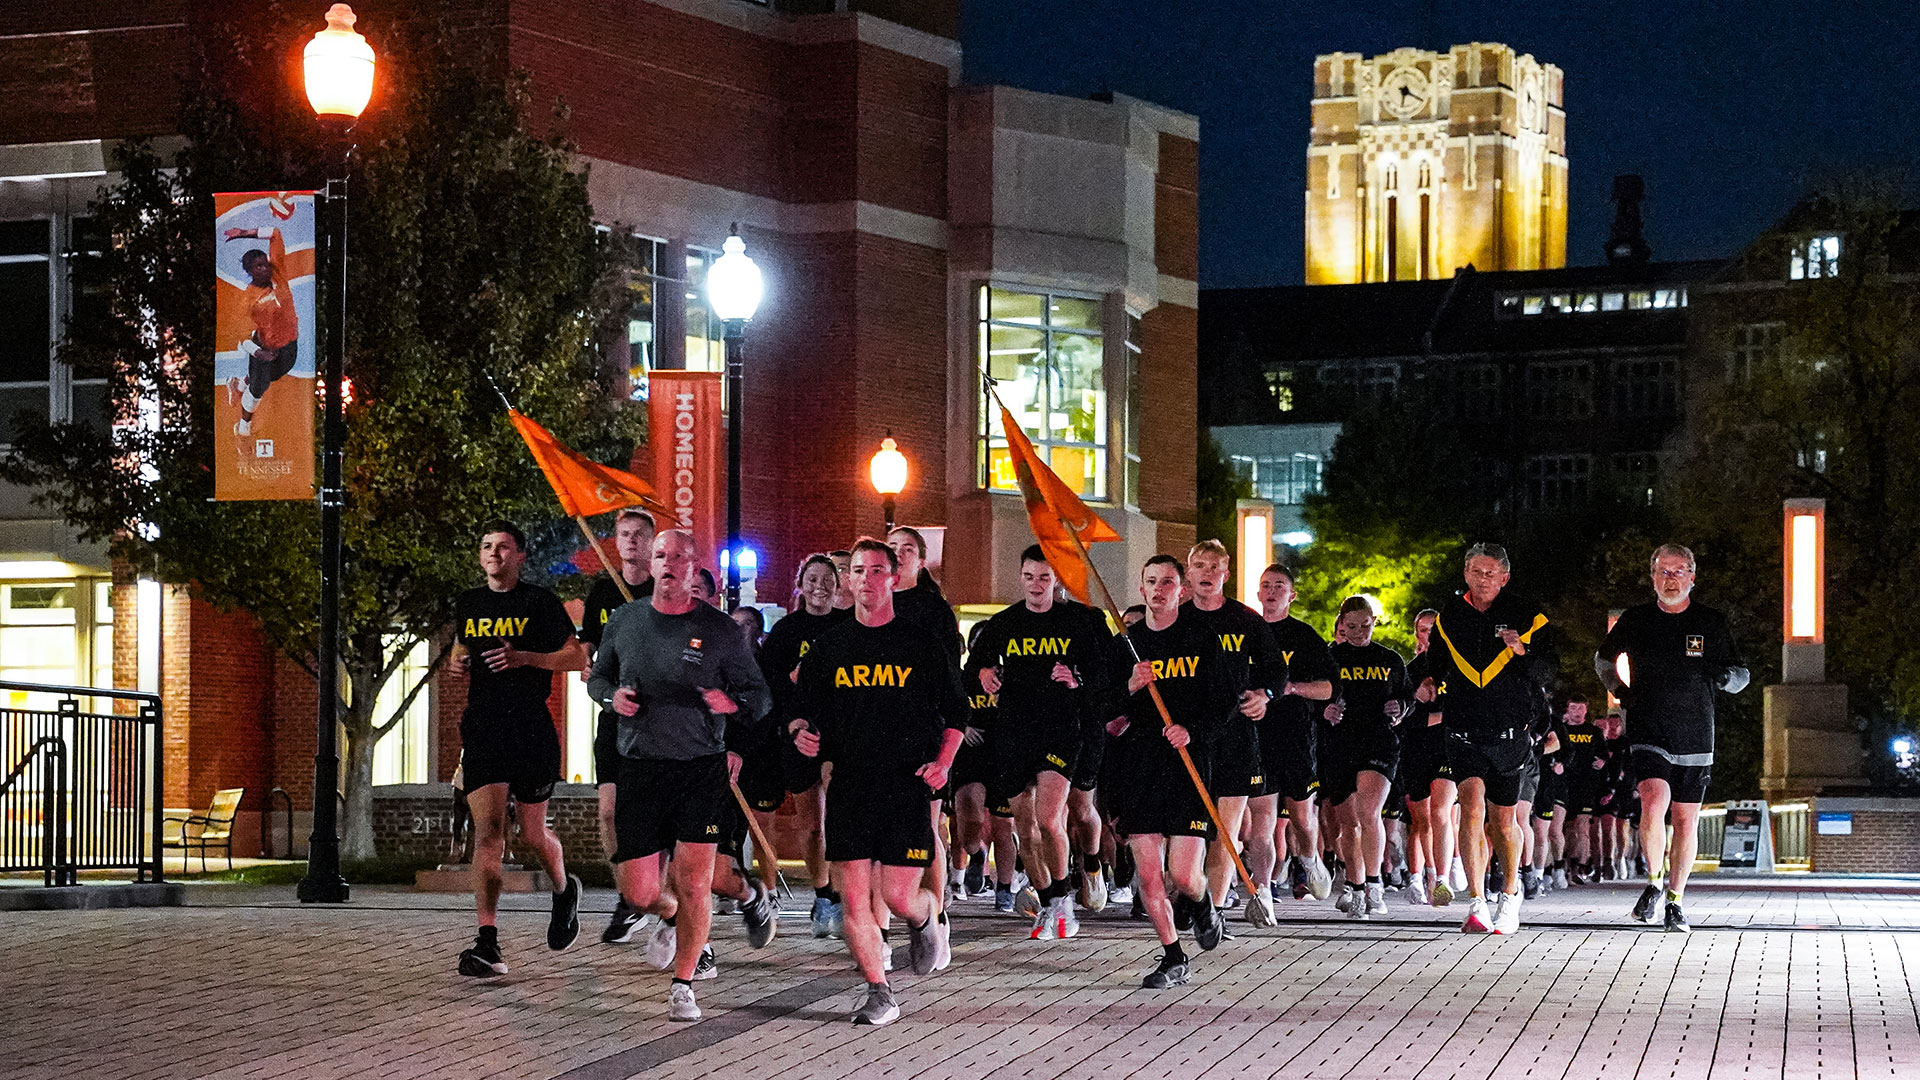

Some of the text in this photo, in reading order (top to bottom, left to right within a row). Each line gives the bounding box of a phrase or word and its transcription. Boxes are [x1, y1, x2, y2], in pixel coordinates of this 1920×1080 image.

[258, 441, 271, 455] T
[465, 617, 529, 638] ARMY
[1006, 637, 1072, 657] ARMY
[835, 664, 913, 688] ARMY
[1151, 656, 1199, 680] RMY
[1340, 666, 1391, 681] ARMY
[1568, 734, 1593, 743] RMY
